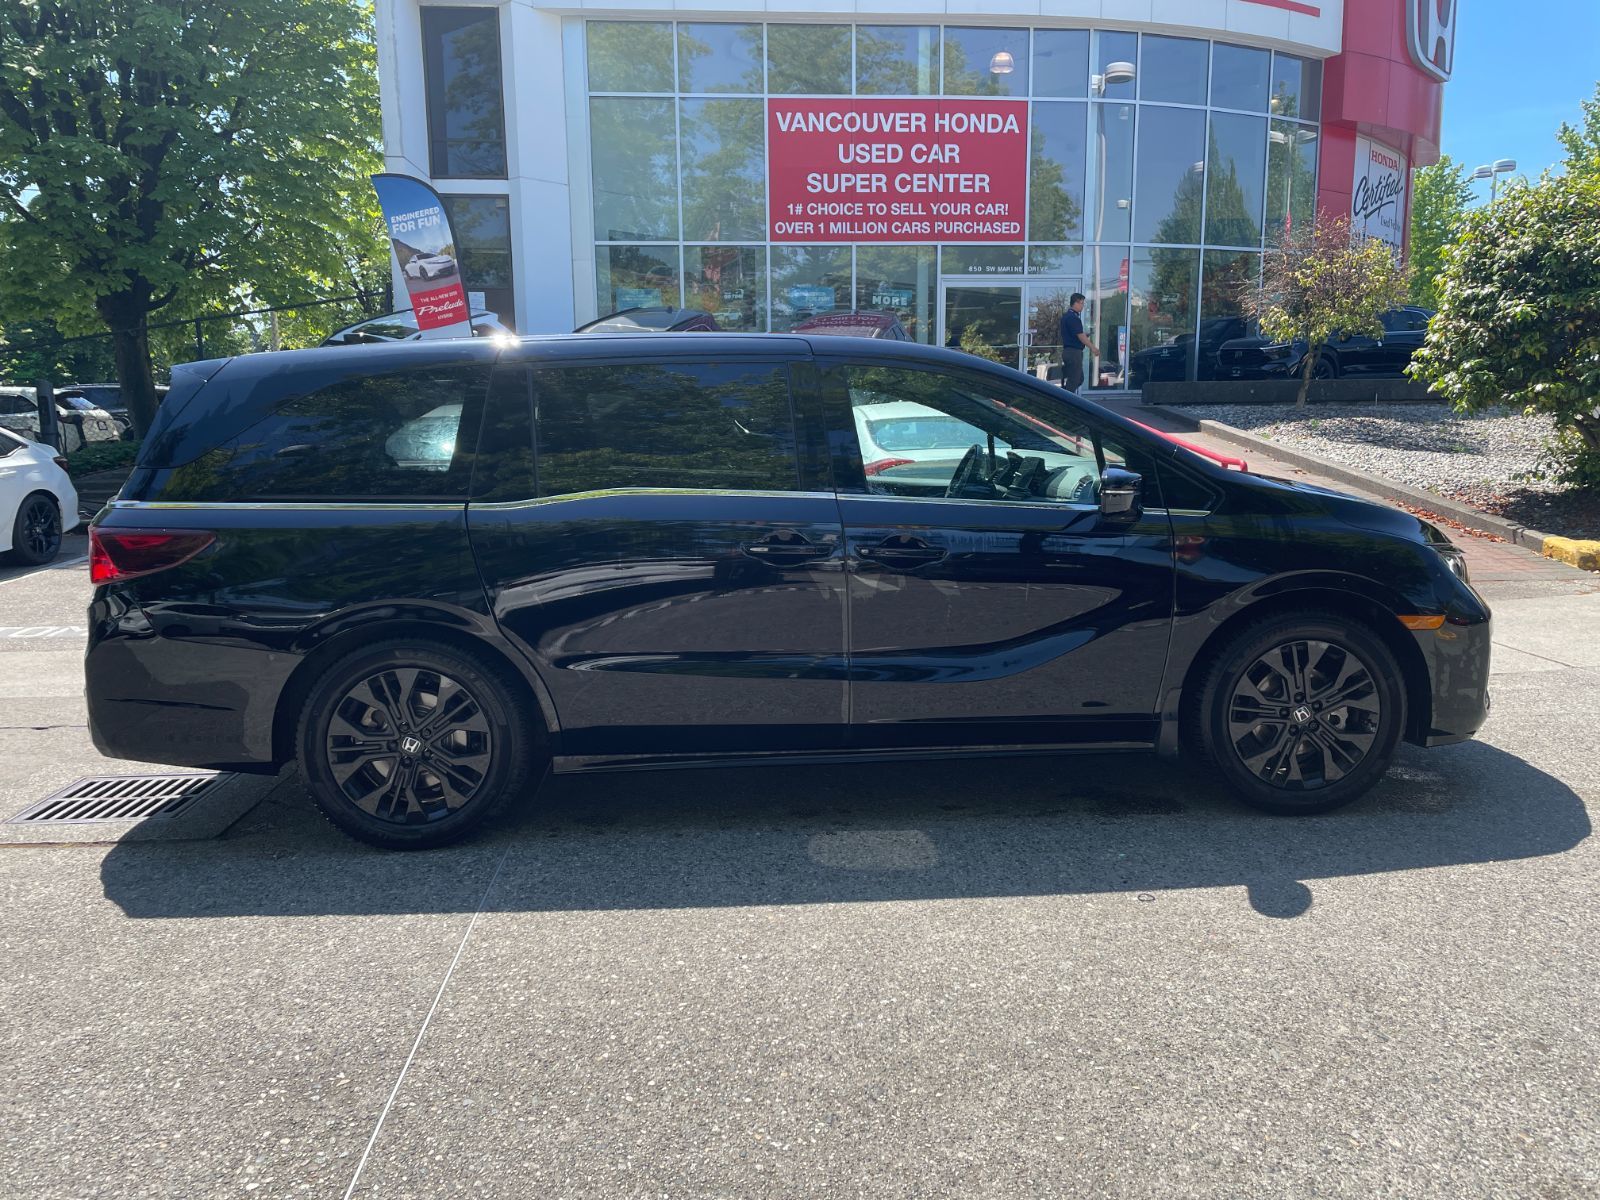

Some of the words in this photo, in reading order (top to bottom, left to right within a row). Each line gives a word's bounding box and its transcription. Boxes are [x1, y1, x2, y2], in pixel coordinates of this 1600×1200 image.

[776, 112, 926, 132] VANCOUVER
[935, 113, 1019, 133] HONDA
[838, 144, 903, 164] USED
[911, 144, 960, 164] CAR
[1371, 150, 1398, 171] HONDA
[806, 173, 887, 193] SUPER
[894, 173, 990, 193] CENTER
[1353, 168, 1403, 218] Certified
[391, 206, 440, 224] ENGINEERED
[787, 203, 803, 215] 1#
[807, 203, 863, 215] CHOICE
[867, 203, 887, 215] TO
[891, 203, 926, 215] SELL
[930, 203, 971, 215] YOUR
[975, 203, 1008, 215] CAR!
[392, 221, 416, 234] FOR
[417, 214, 441, 229] FUN
[775, 222, 814, 234] OVER
[818, 222, 824, 234] 1
[829, 222, 888, 234] MILLION
[891, 222, 931, 234] CARS
[935, 222, 1020, 234] PURCHASED
[417, 299, 464, 316] Prelude
[872, 296, 908, 306] MORE
